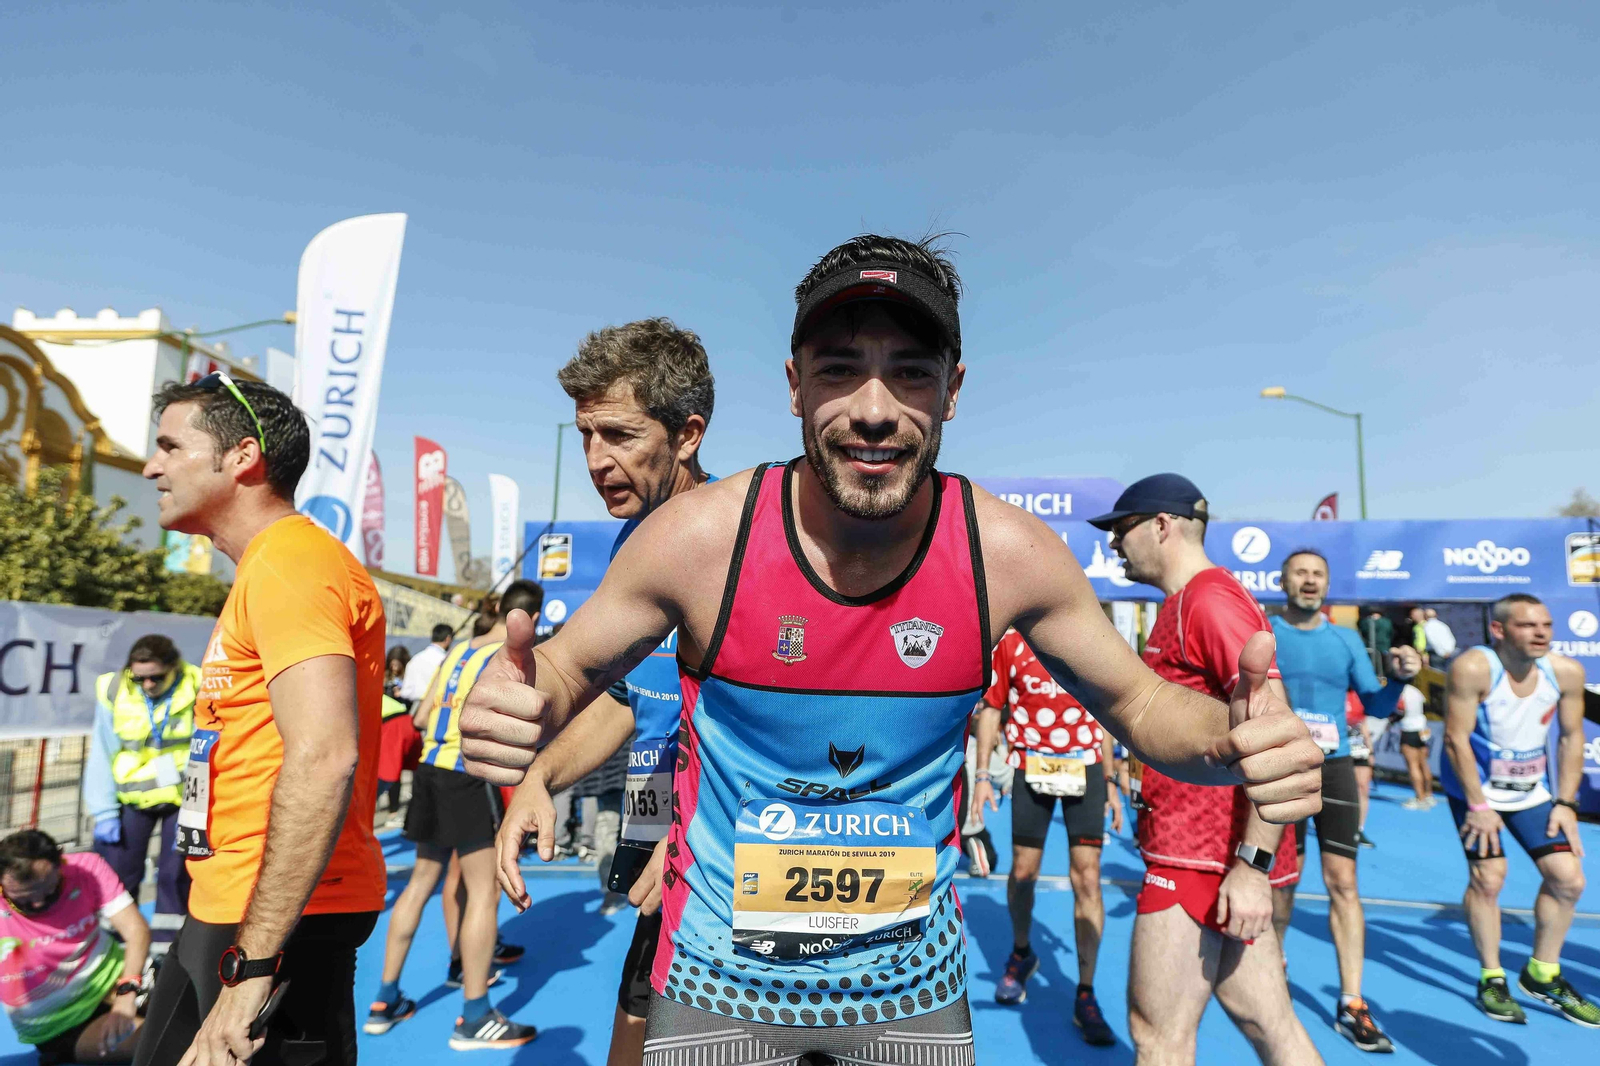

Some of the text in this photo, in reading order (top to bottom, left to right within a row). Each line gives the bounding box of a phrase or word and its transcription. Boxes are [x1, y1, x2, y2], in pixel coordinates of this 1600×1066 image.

[317, 308, 366, 473] ZURICH
[998, 492, 1073, 516] RICH
[890, 620, 944, 636] TITANES
[661, 693, 680, 701] 2019
[776, 777, 892, 801] SPALL
[624, 789, 659, 817] 0153
[804, 812, 911, 836] ZURICH
[779, 848, 805, 856] ZURICH
[806, 848, 840, 857] MARATÓN
[784, 866, 885, 904] 2597
[808, 916, 859, 930] LUISFER
[865, 926, 912, 944] ZURICH
